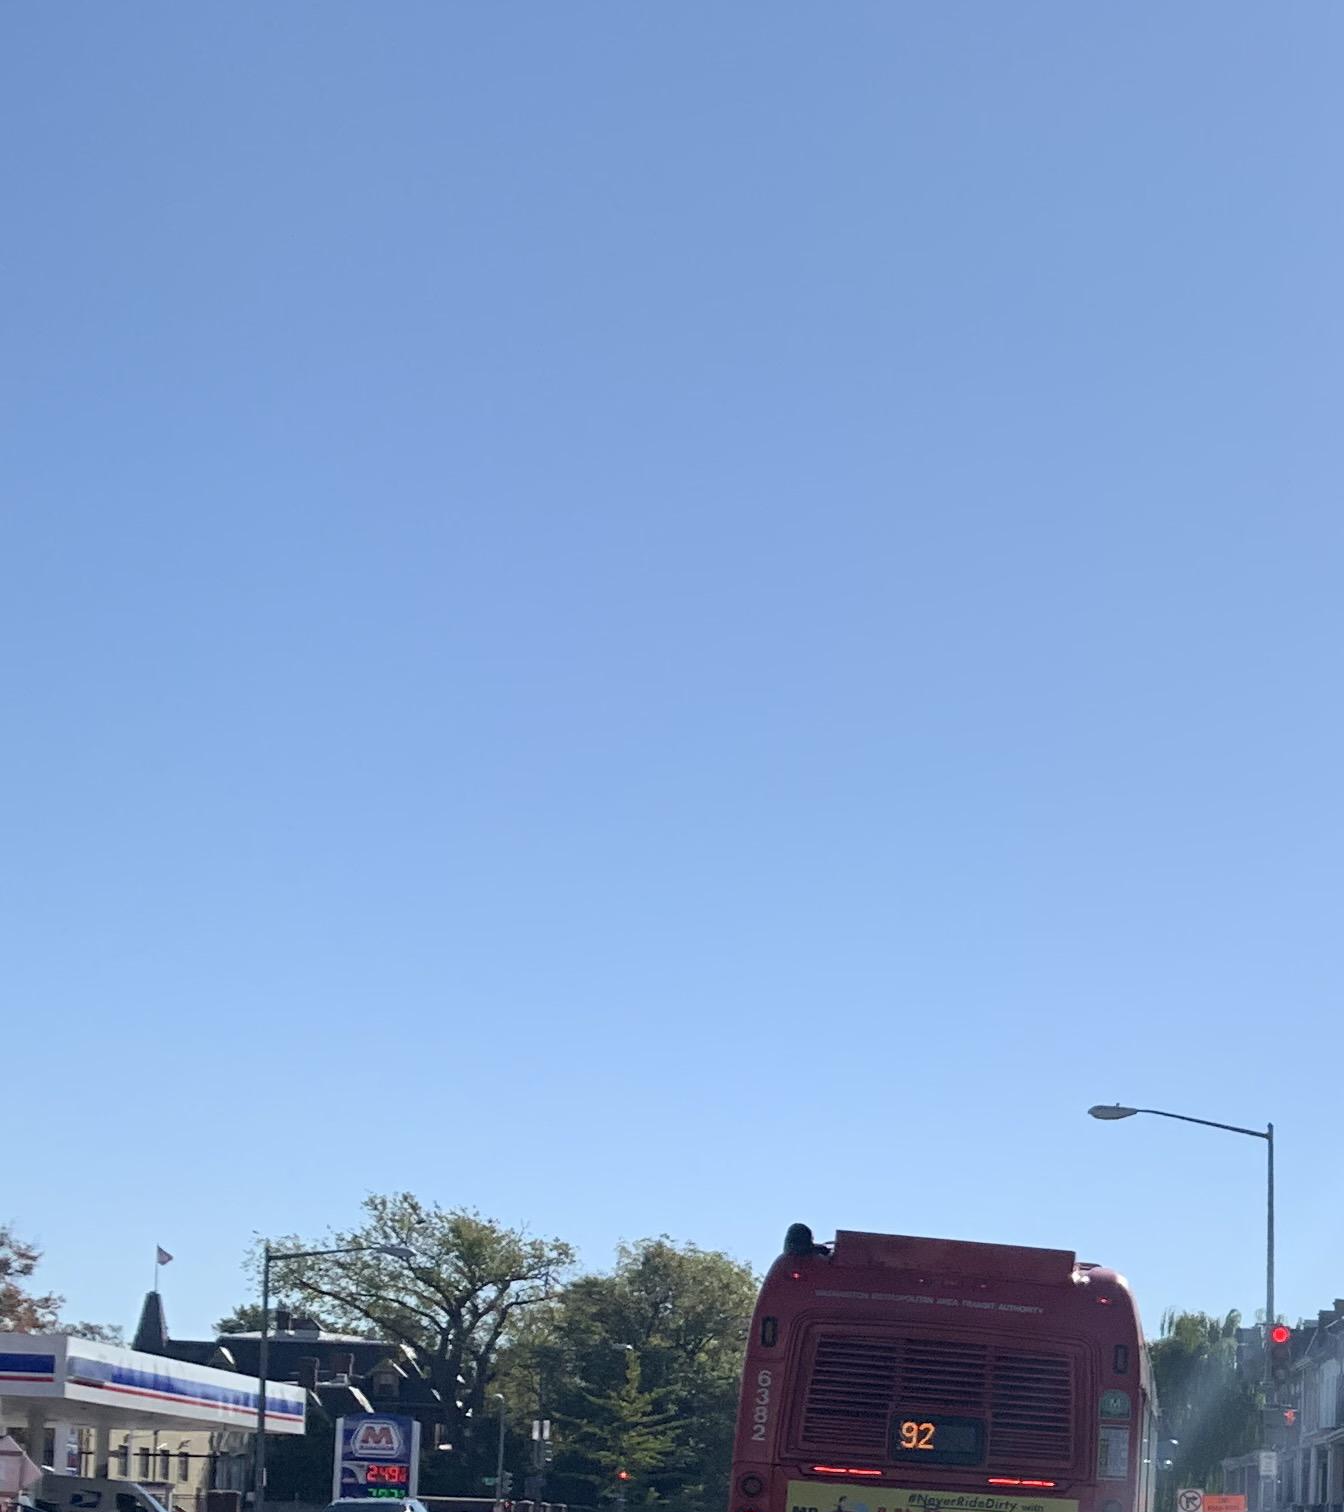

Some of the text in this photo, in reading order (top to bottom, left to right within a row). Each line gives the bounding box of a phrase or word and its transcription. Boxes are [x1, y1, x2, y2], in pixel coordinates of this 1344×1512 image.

[752, 1370, 772, 1441] 6382
[901, 1420, 937, 1451] 92
[1022, 1503, 1044, 1512] with
